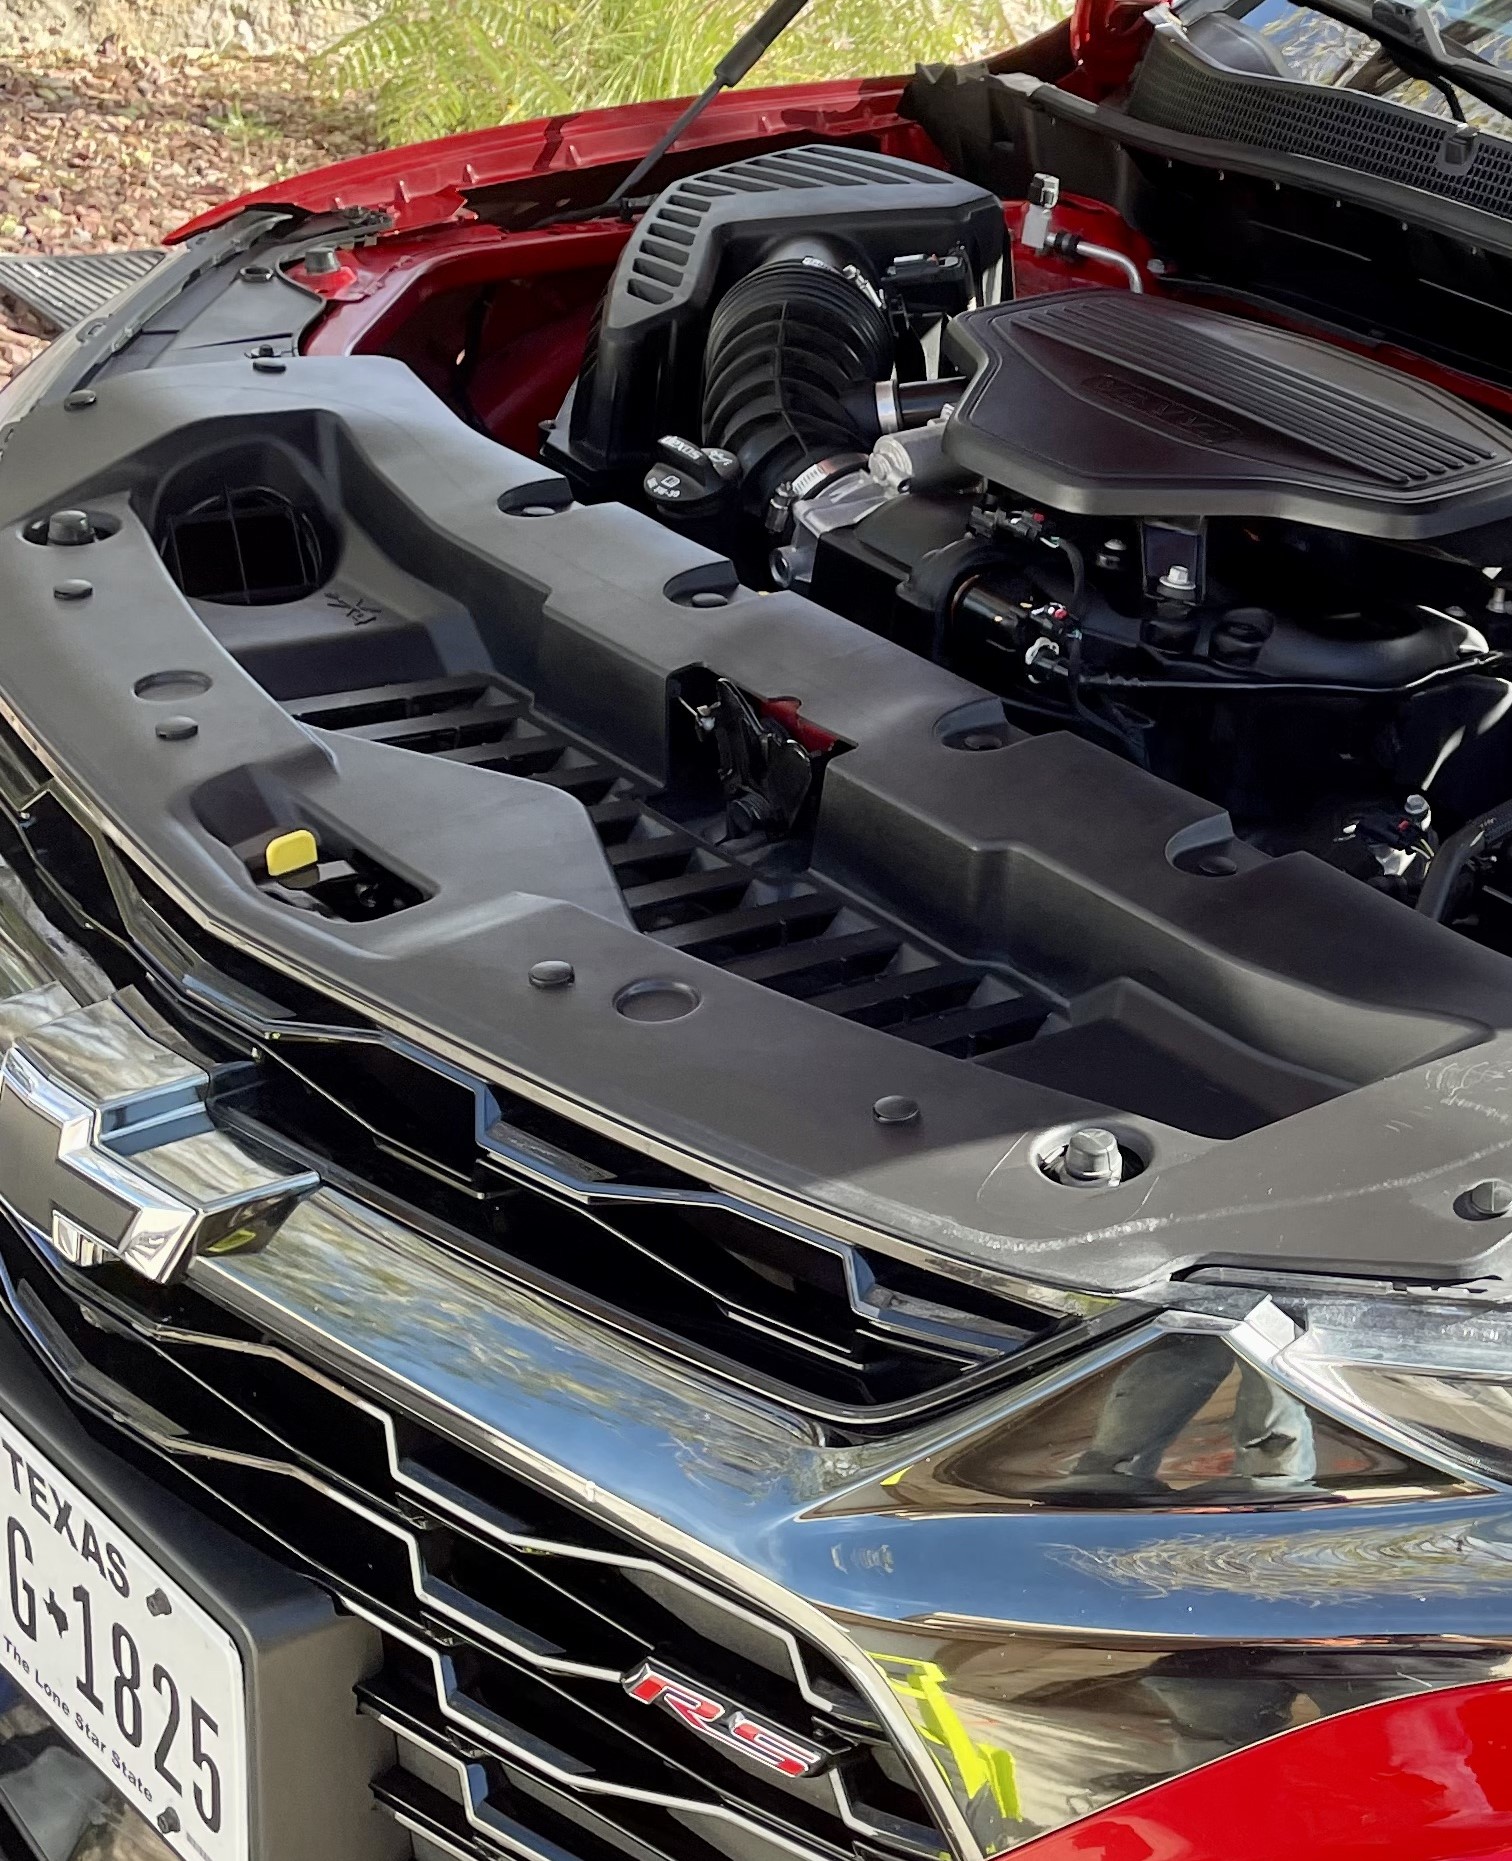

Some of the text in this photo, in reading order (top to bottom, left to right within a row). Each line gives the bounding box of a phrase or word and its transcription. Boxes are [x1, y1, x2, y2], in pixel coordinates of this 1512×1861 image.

[3, 1439, 130, 1598] TEXAS
[4, 1635, 152, 1802] The Lone Star State
[627, 1662, 821, 1778] RS
